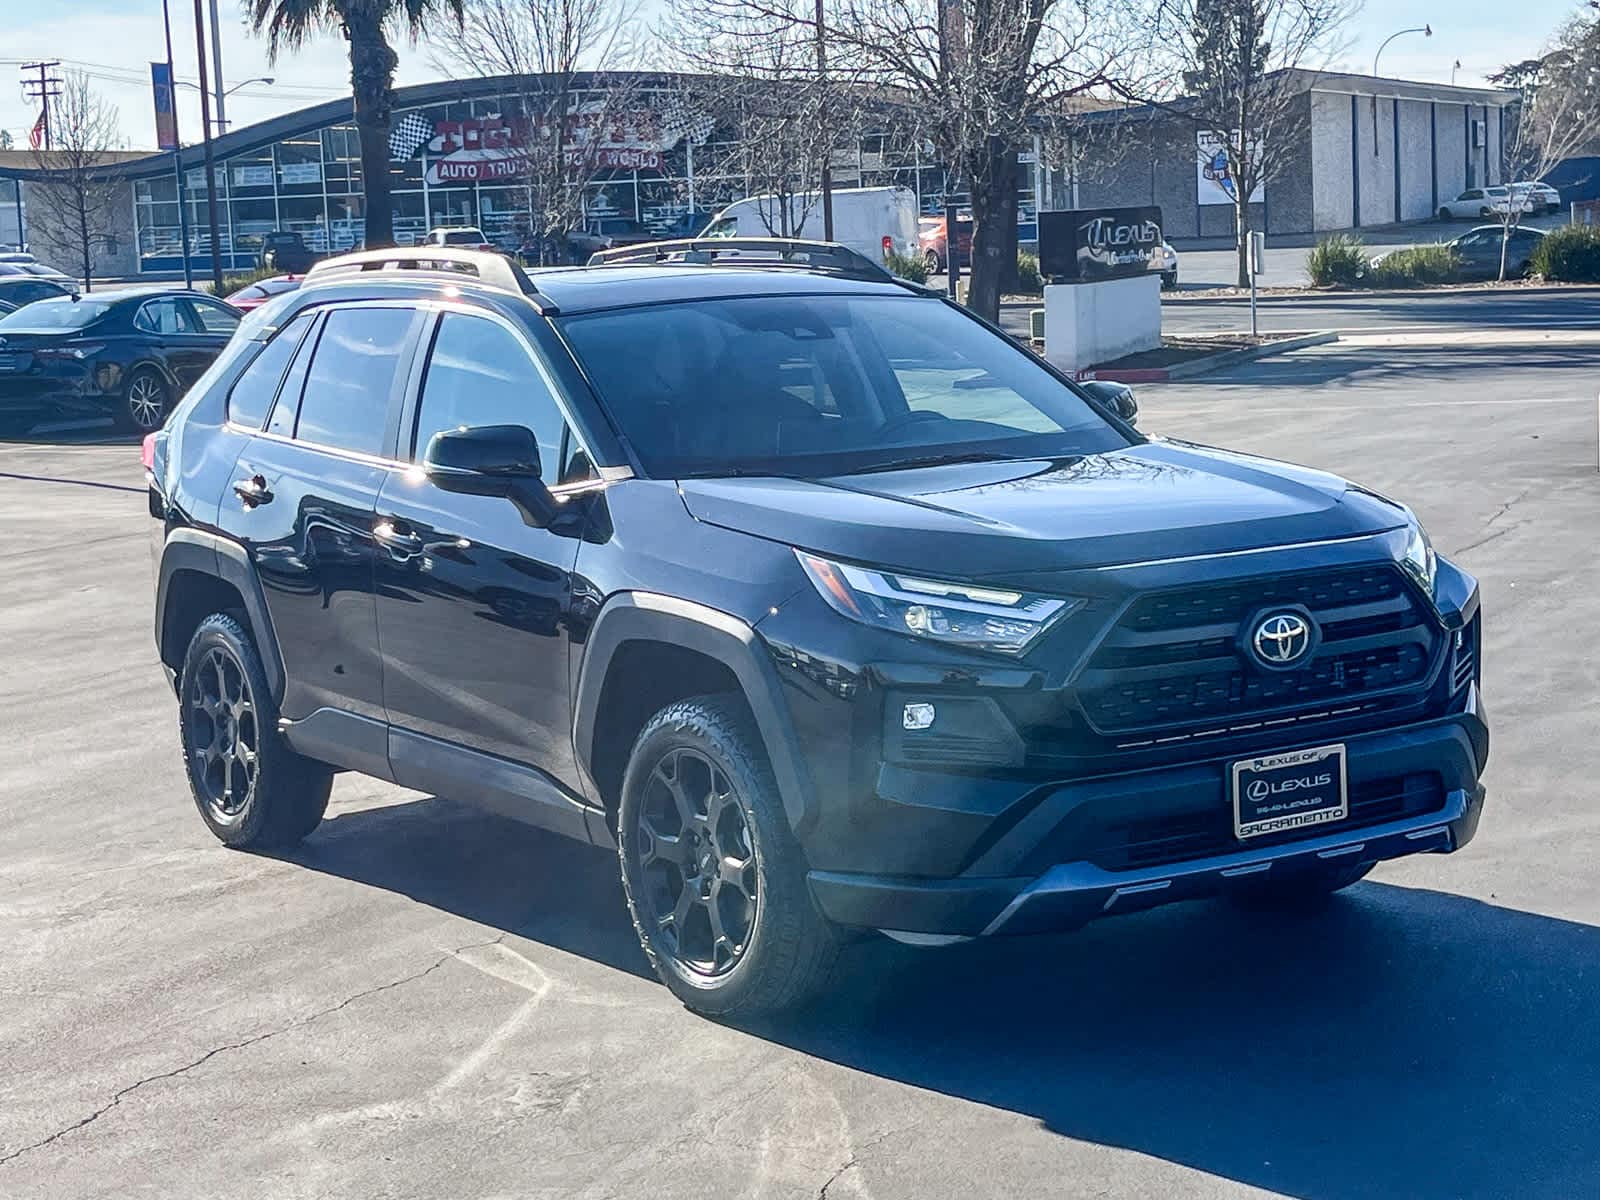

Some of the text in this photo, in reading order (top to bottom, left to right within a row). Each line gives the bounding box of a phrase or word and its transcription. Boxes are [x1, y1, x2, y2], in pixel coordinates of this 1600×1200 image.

[440, 164, 477, 177] AUTO
[1106, 224, 1155, 245] LEXUS
[1261, 751, 1317, 768] LEXUS OF
[1271, 773, 1331, 794] LEXUS
[1239, 809, 1343, 836] SACRAMENTO
